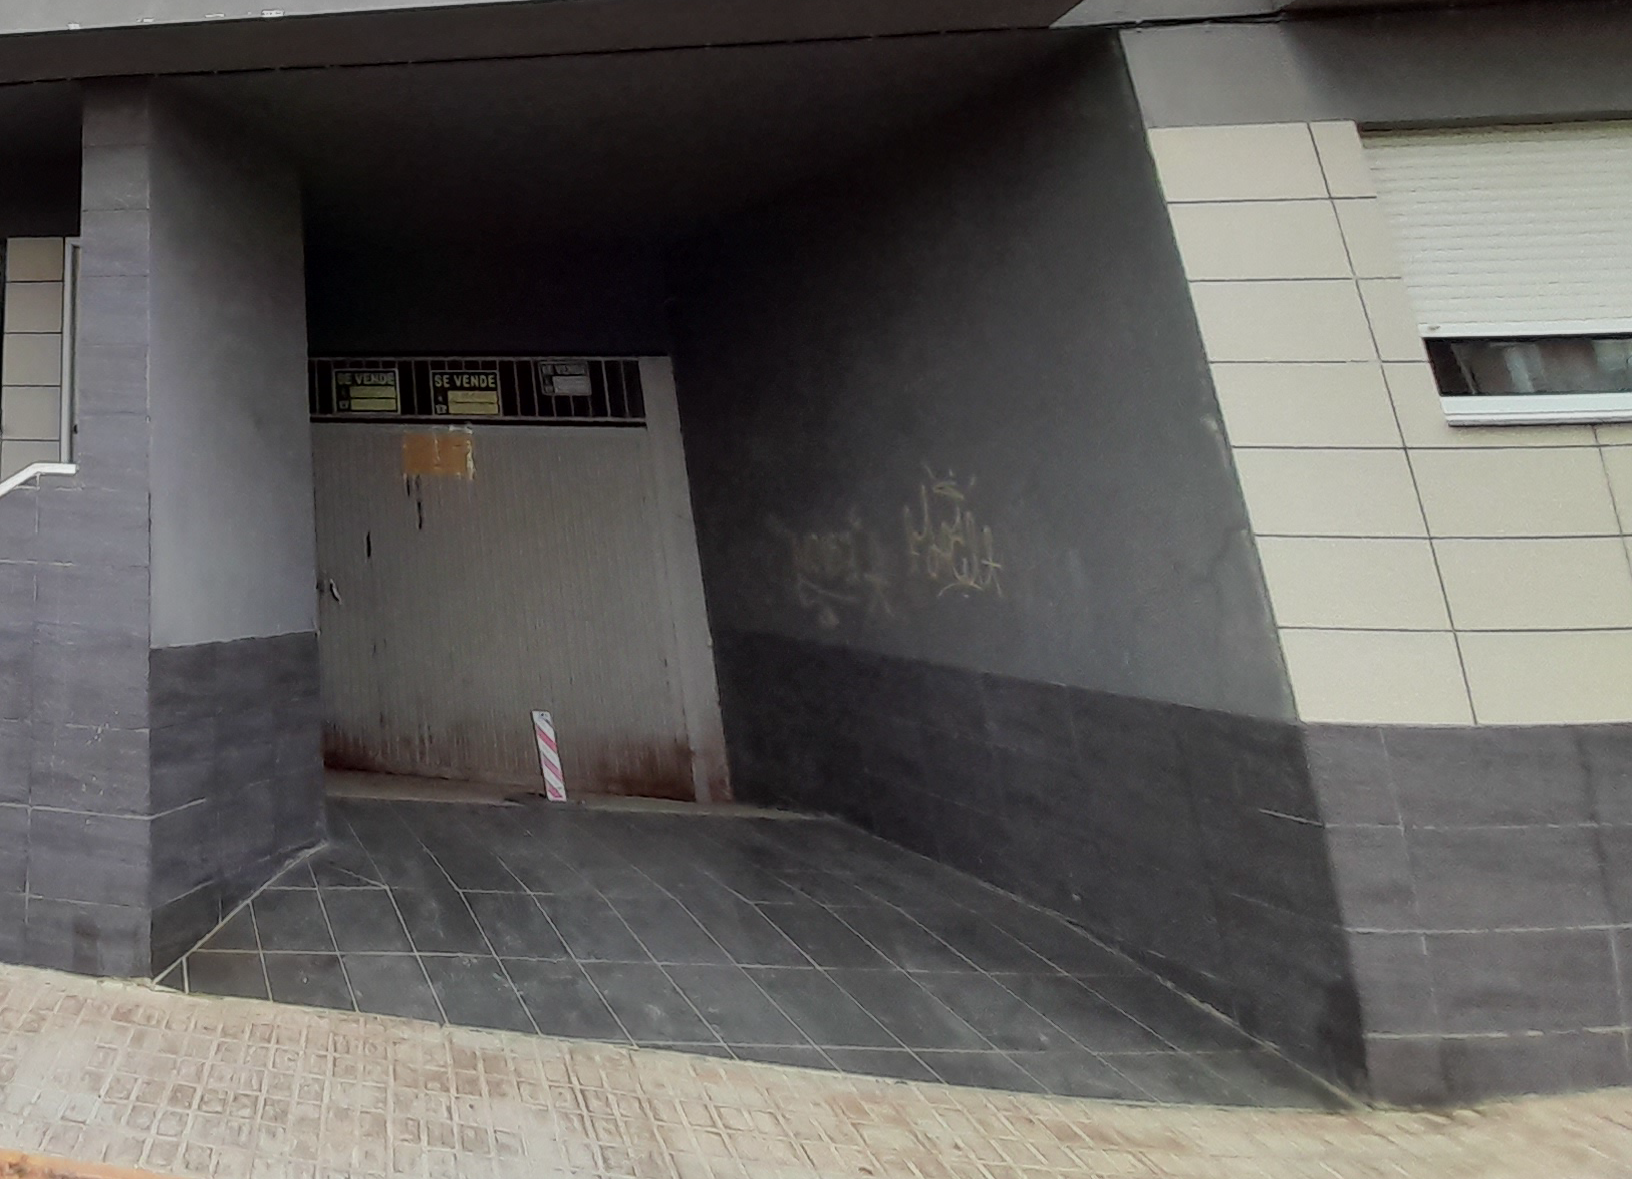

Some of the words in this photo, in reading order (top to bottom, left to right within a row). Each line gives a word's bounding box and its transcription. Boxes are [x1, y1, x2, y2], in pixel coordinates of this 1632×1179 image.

[354, 372, 395, 385] VENDE
[434, 374, 451, 388] SE
[453, 374, 497, 388] VENDE
